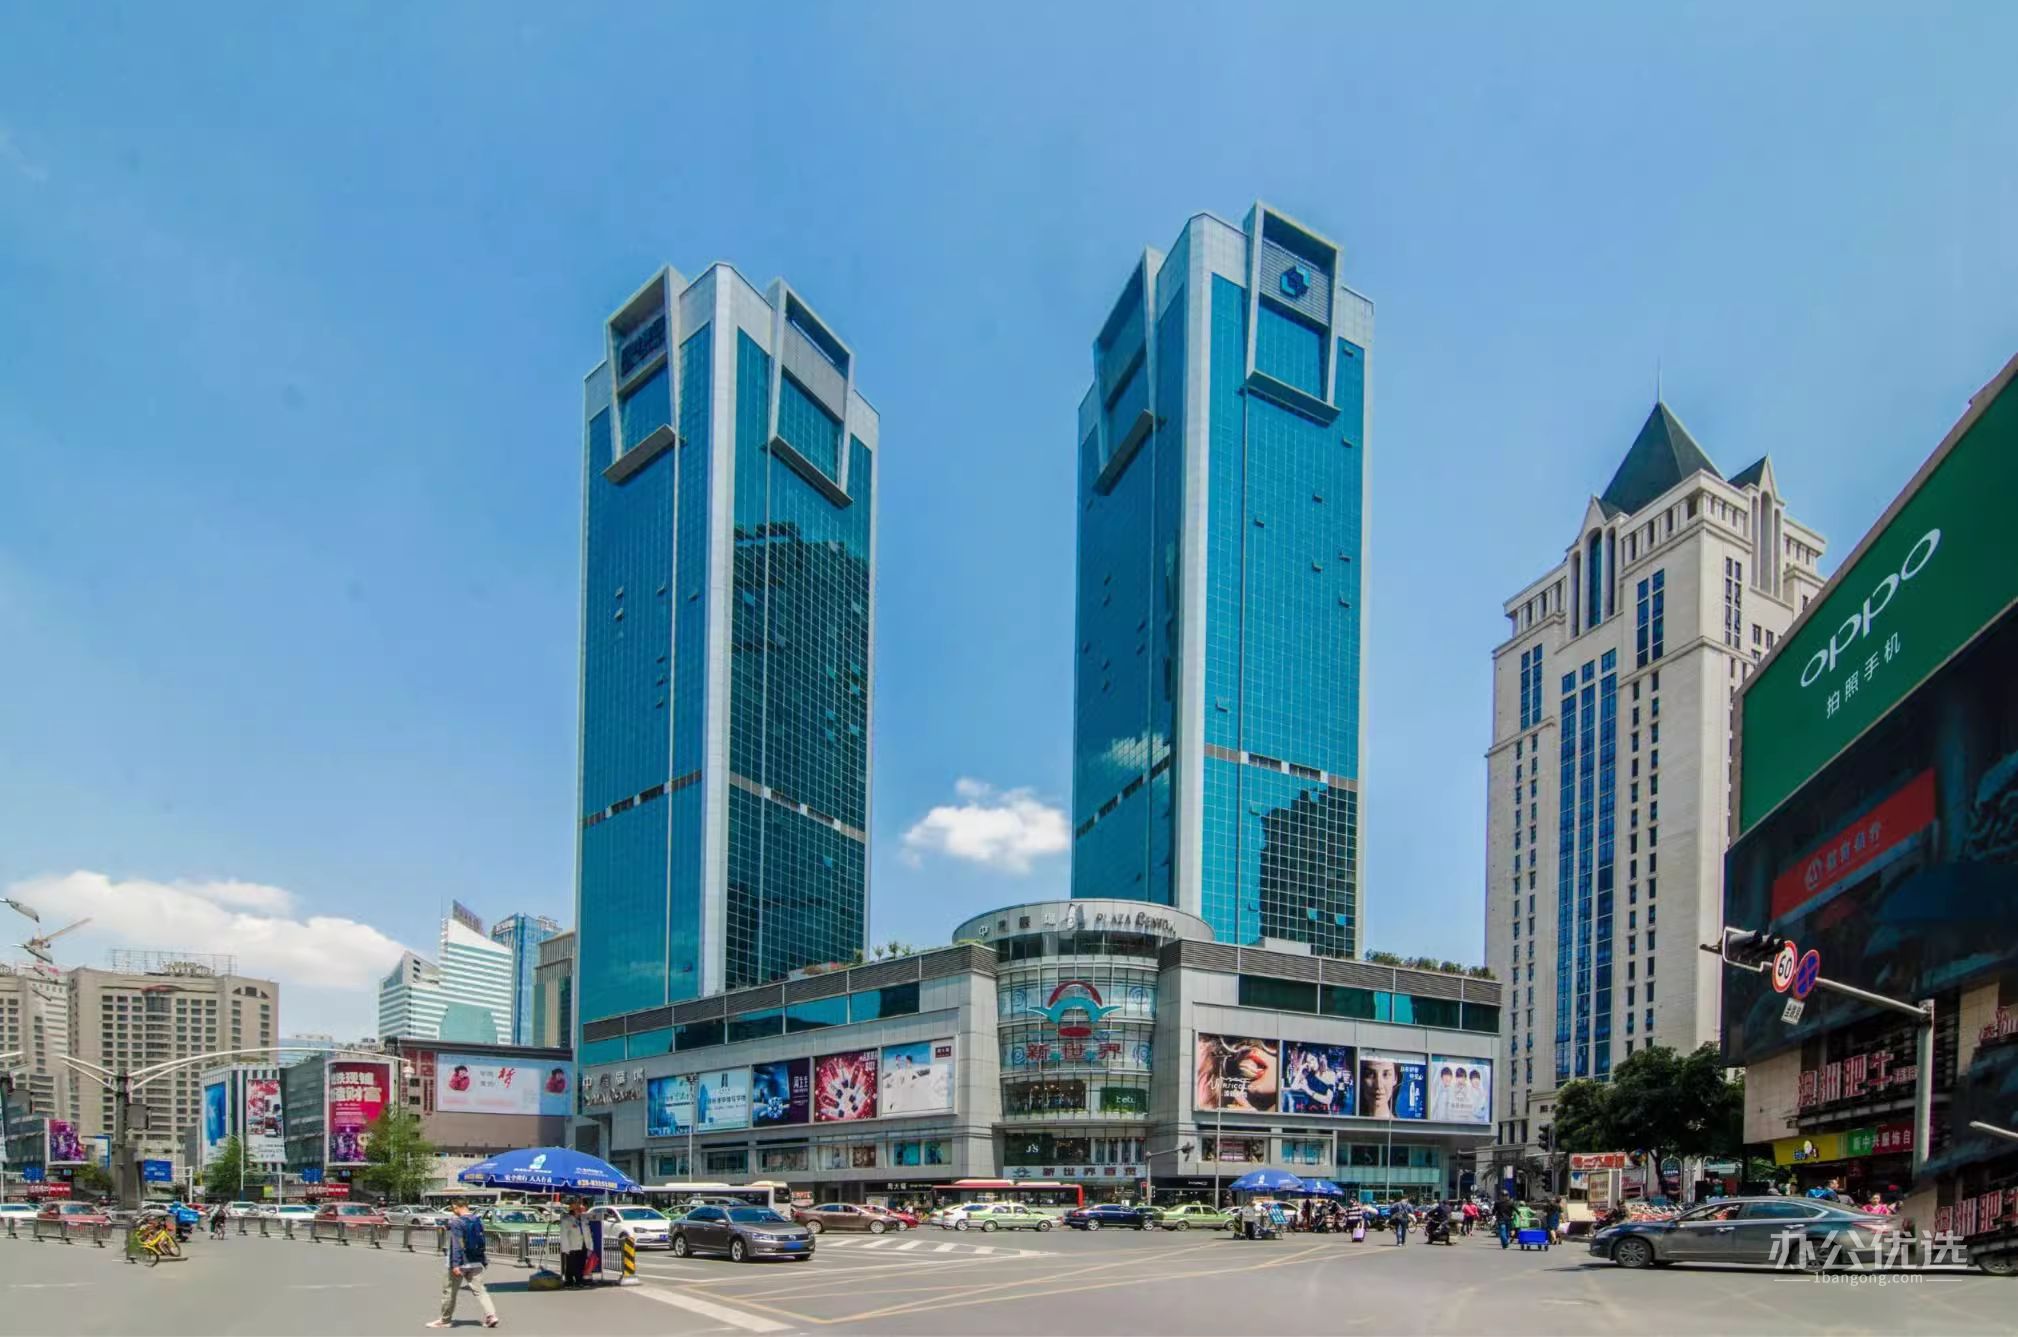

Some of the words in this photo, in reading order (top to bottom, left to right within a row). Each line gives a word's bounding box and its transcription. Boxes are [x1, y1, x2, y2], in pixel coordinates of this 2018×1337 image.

[1826, 631, 1901, 719] 拍照手机
[1777, 955, 1792, 979] 60
[1026, 1042, 1122, 1061] 新世界
[1797, 1049, 1895, 1109] 澳洲肥牛
